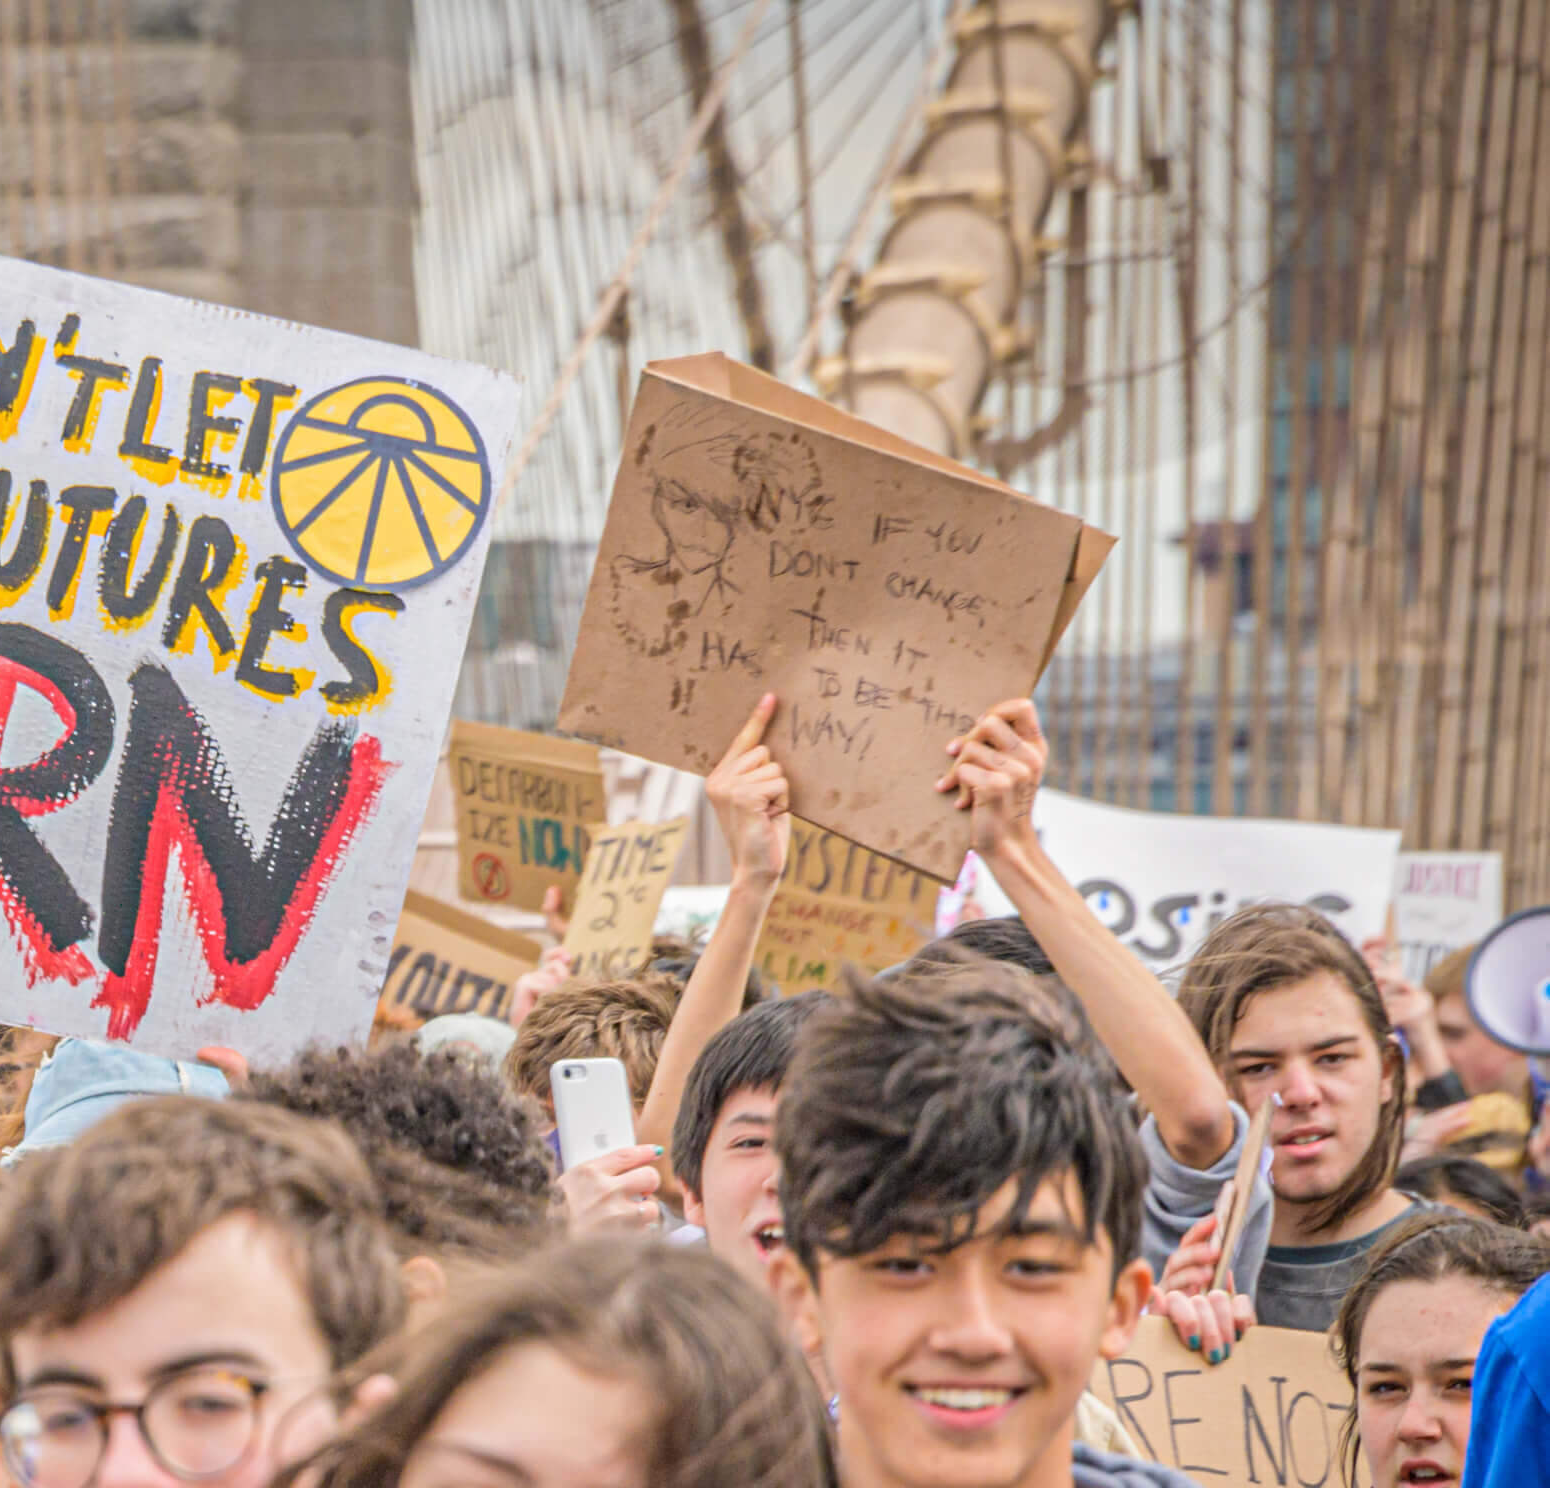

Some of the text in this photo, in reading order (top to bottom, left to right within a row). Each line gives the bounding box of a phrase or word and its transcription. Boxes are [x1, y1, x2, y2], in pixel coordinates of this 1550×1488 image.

[118, 355, 300, 500] LET
[873, 513, 913, 544] IF
[925, 520, 984, 555] YOU
[788, 607, 929, 672] THEN IT
[812, 667, 843, 699] TO
[853, 676, 894, 710] BE
[790, 705, 875, 762] WAY!
[593, 825, 681, 885] TIME
[780, 830, 923, 903] YSTEM
[1086, 1358, 1229, 1476] RE
